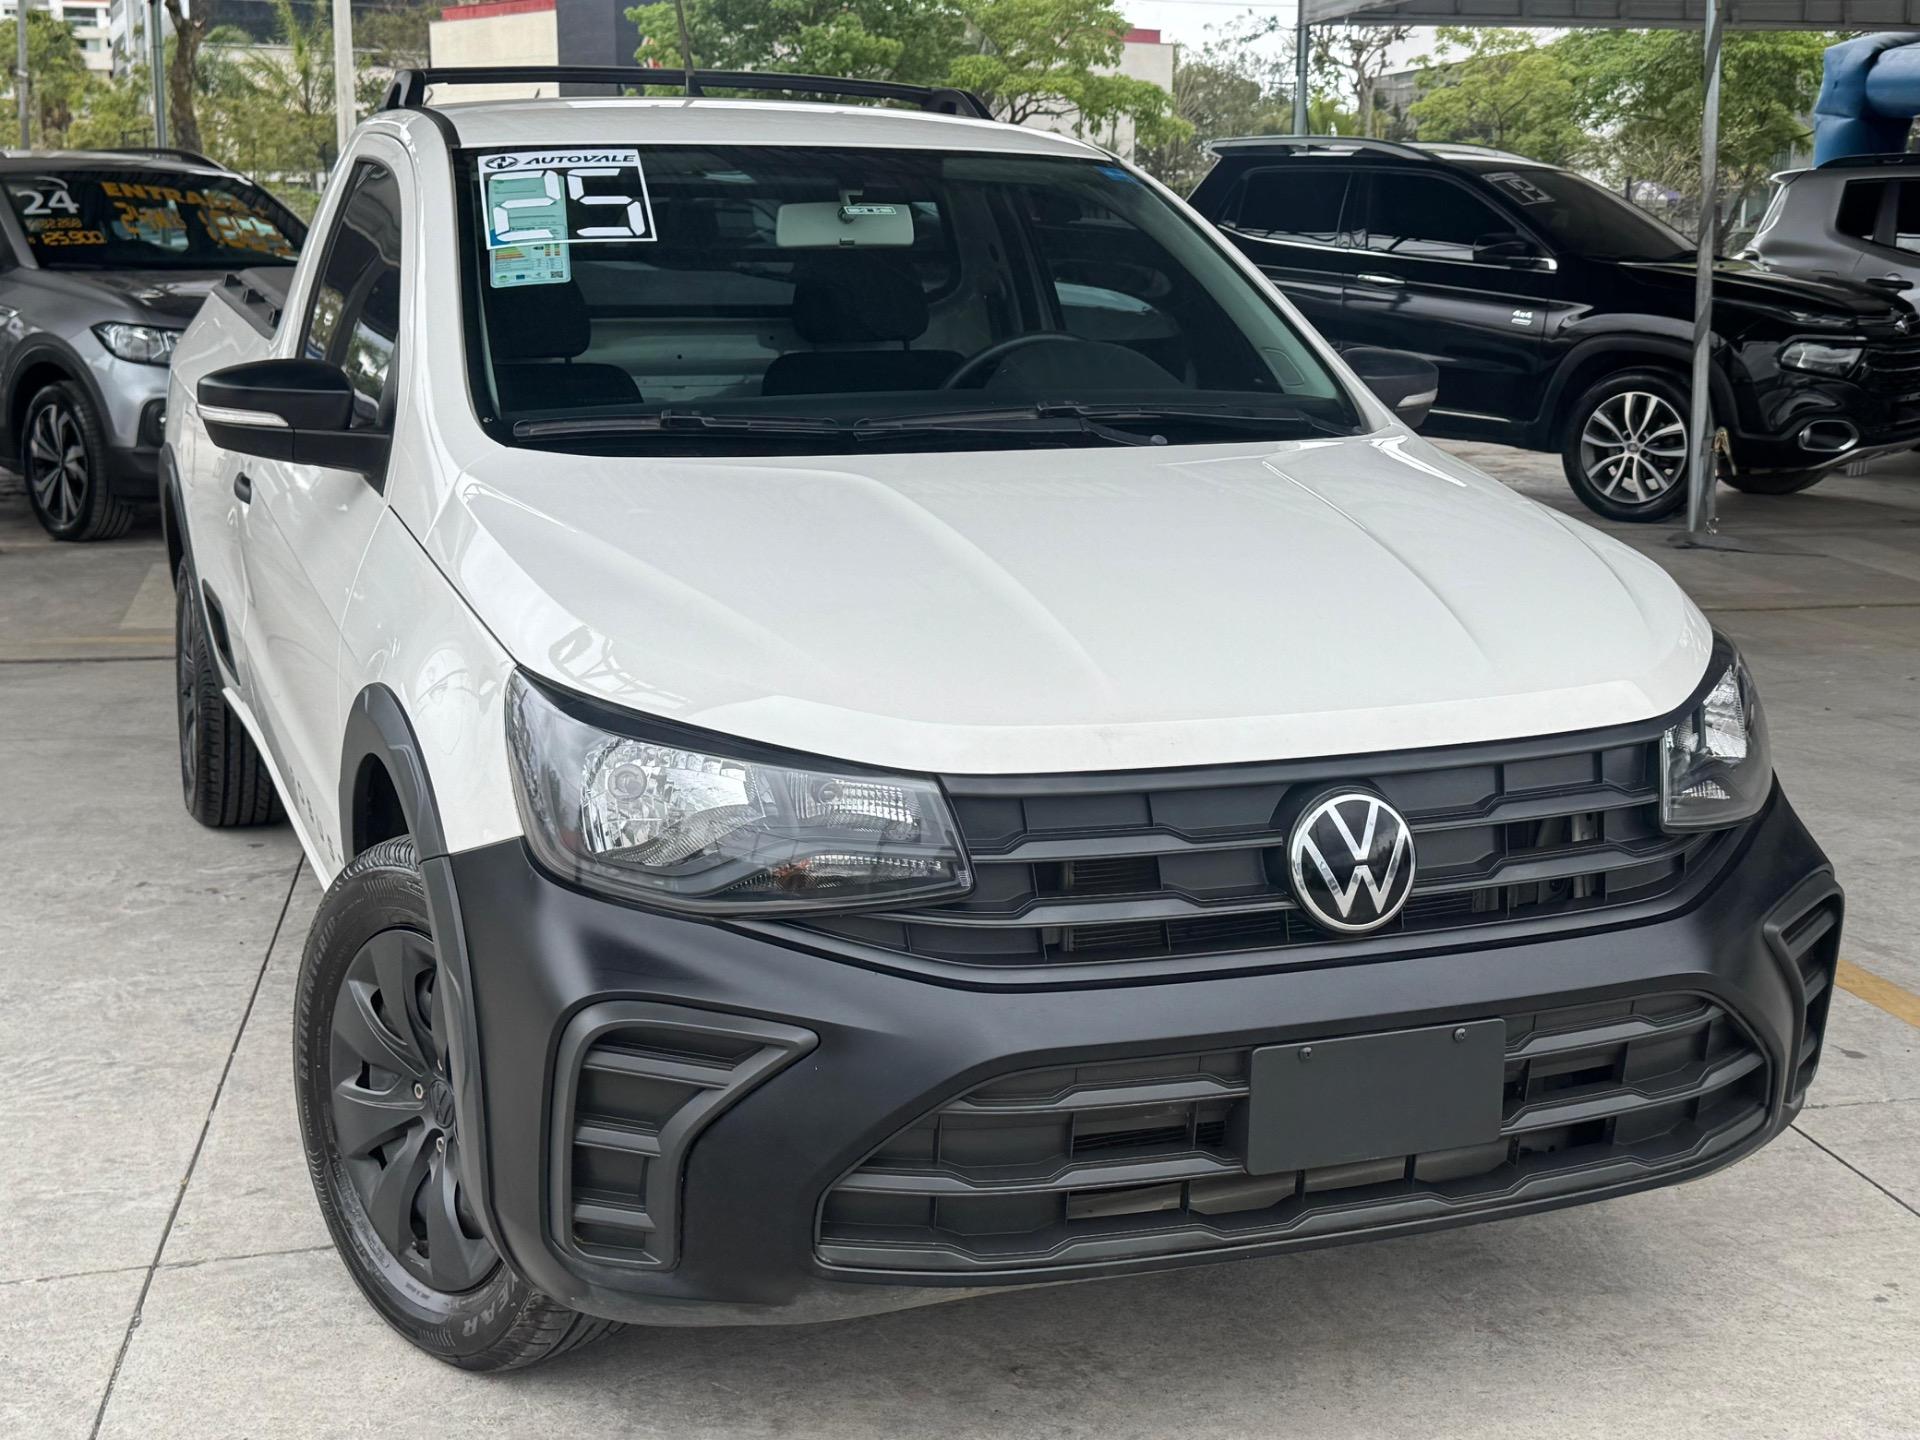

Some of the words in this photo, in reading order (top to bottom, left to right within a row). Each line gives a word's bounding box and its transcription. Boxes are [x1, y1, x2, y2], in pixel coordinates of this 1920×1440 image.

[523, 154, 636, 166] AUTOVALE
[15, 190, 80, 215] 24
[489, 168, 646, 242] 25
[1300, 797, 1410, 921] VW
